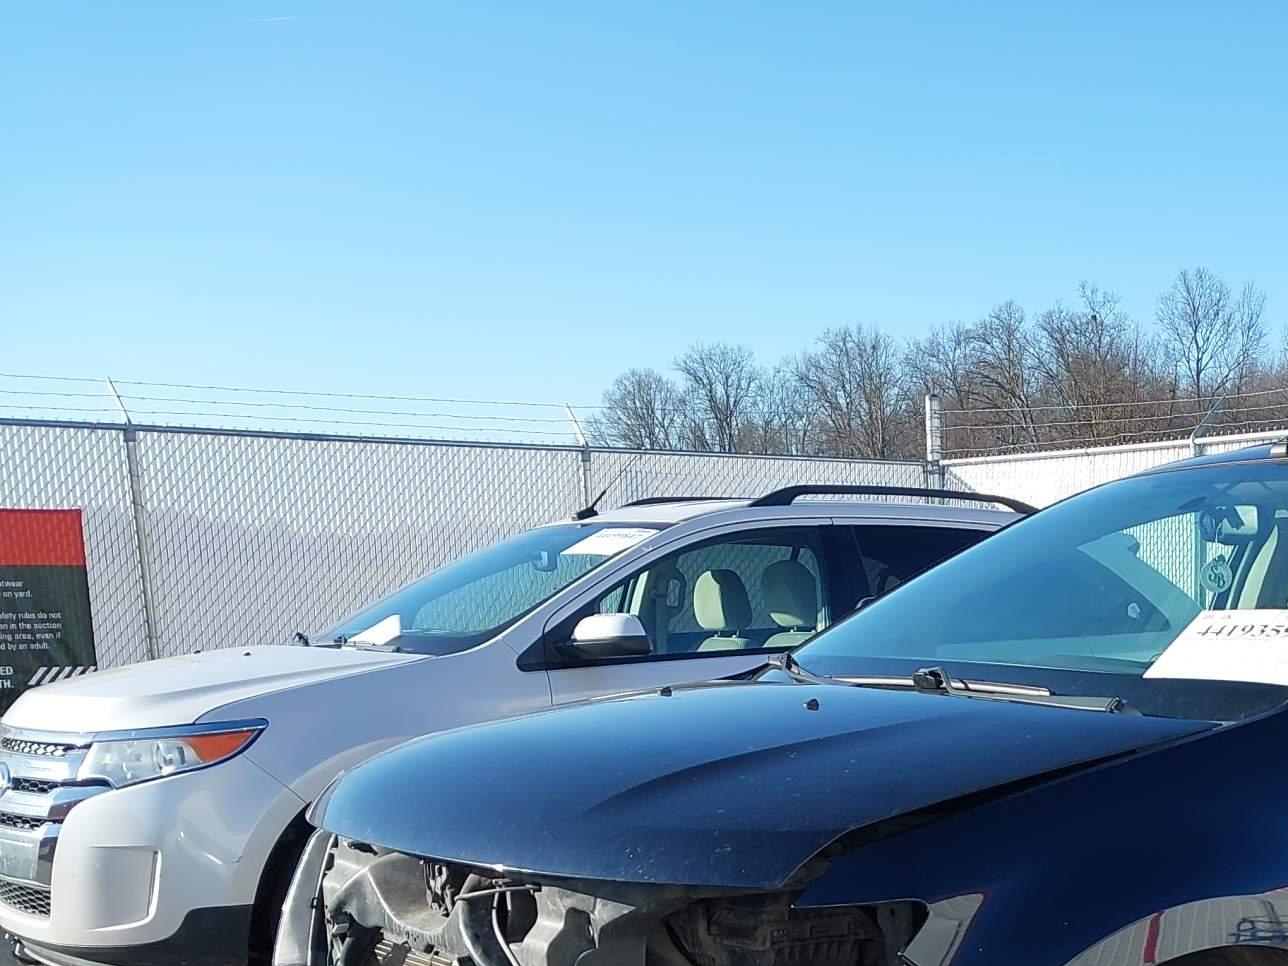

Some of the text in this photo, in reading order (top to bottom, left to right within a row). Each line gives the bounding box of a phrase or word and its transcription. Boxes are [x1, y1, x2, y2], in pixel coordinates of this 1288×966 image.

[13, 590, 33, 599] yard.
[18, 611, 36, 619] rules
[37, 611, 47, 619] do
[19, 621, 32, 629] the
[56, 631, 61, 639] if
[7, 642, 16, 651] by
